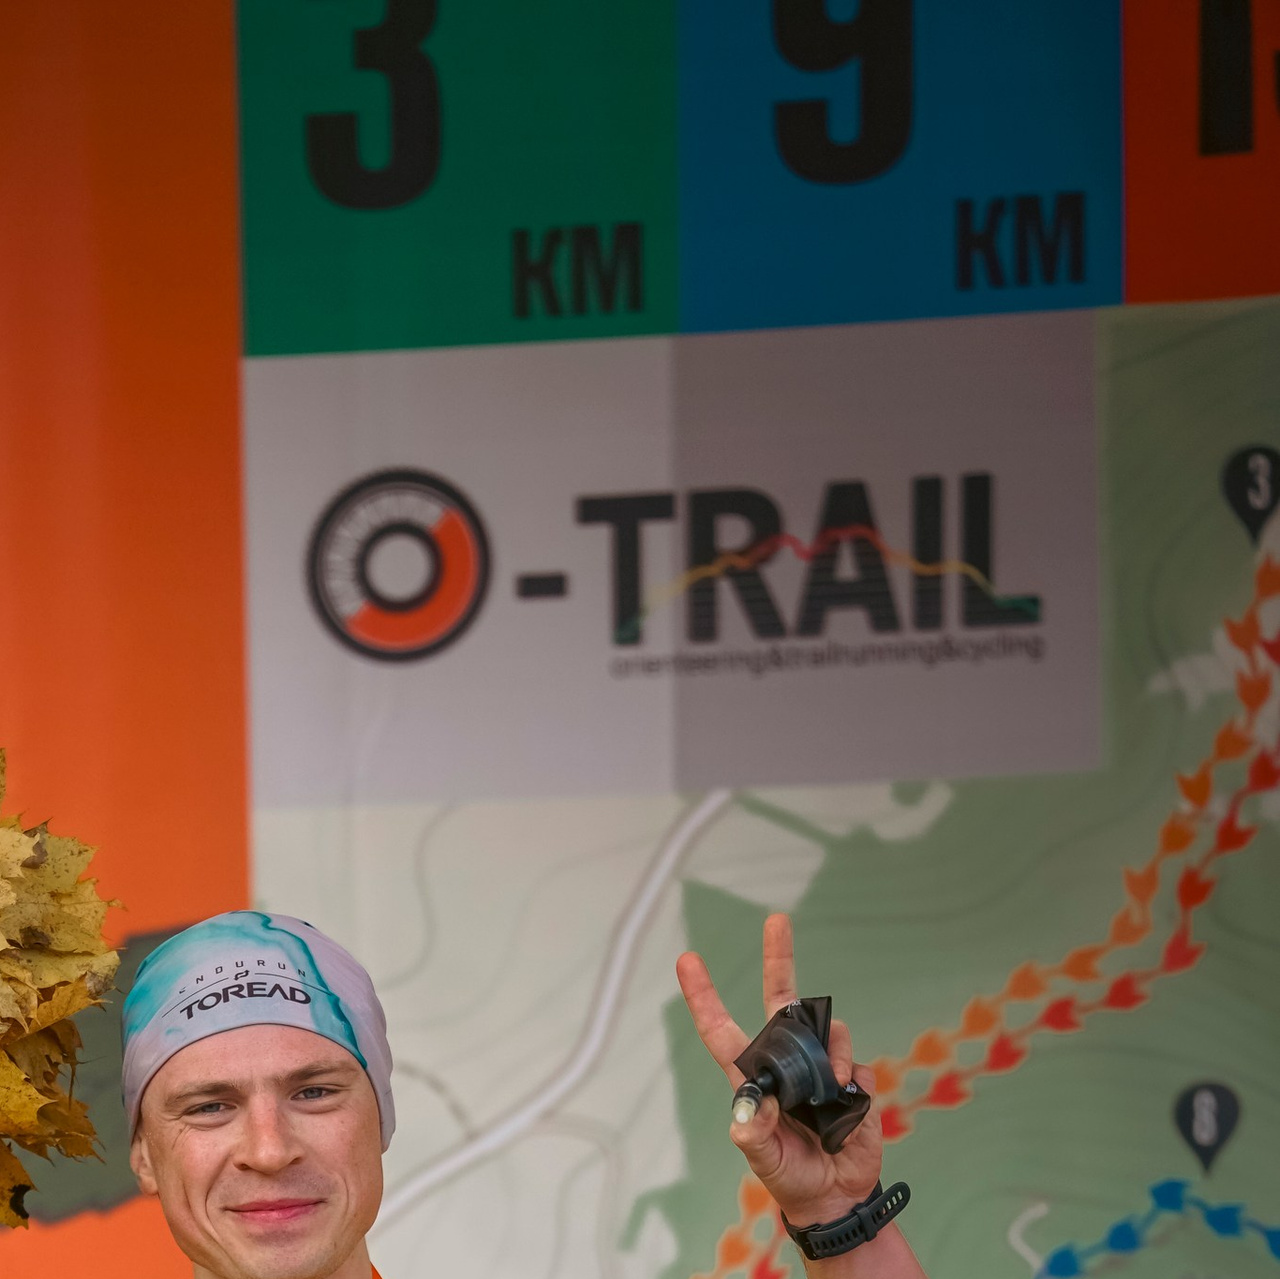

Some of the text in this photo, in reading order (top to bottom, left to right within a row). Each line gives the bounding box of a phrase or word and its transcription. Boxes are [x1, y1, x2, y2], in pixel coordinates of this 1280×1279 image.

[304, 0, 443, 210] 3
[771, 0, 914, 186] 9
[1247, 453, 1272, 511] 3
[180, 982, 311, 1020] TOREAD
